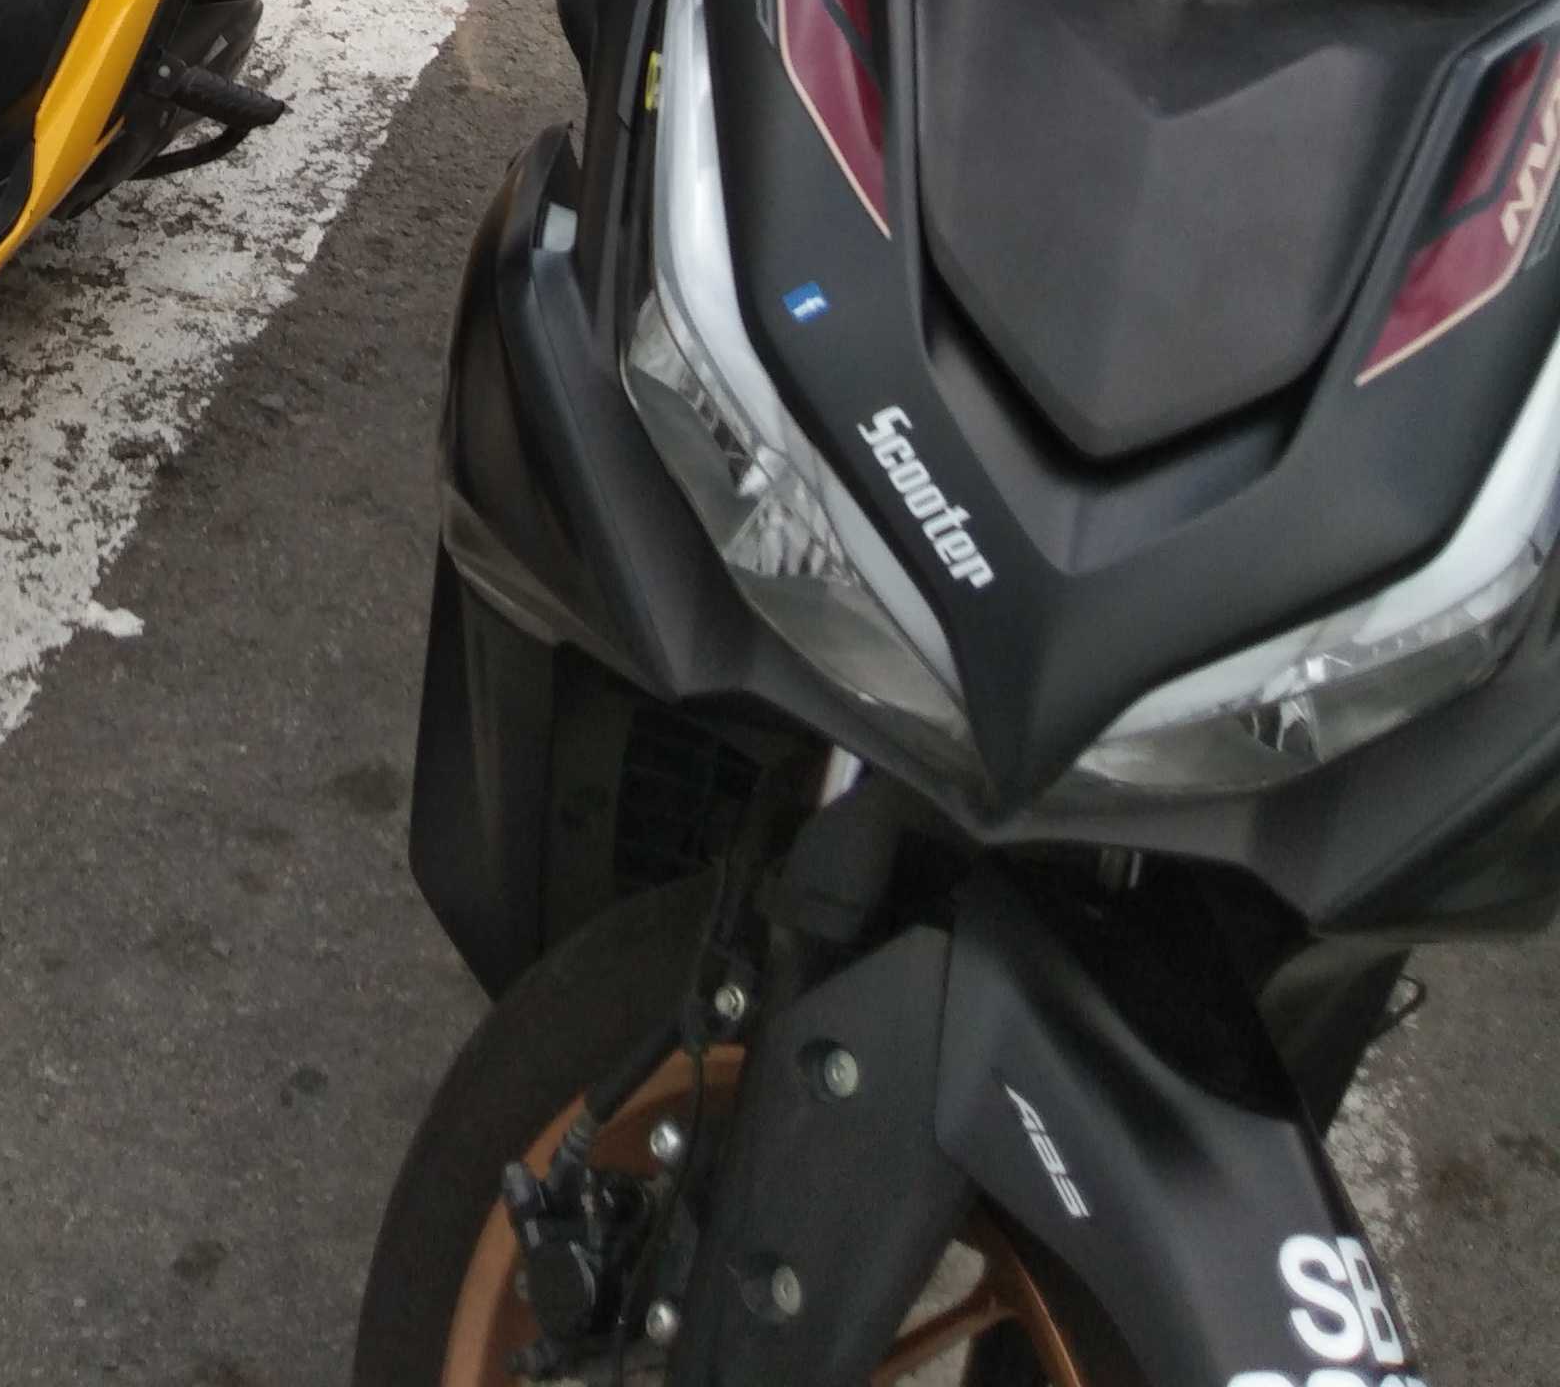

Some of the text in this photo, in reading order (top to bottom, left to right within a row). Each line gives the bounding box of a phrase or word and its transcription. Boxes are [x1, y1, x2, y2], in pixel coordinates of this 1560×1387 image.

[856, 404, 996, 590] Scooter
[1004, 1083, 1091, 1218] ABS
[1279, 1234, 1404, 1365] SB
